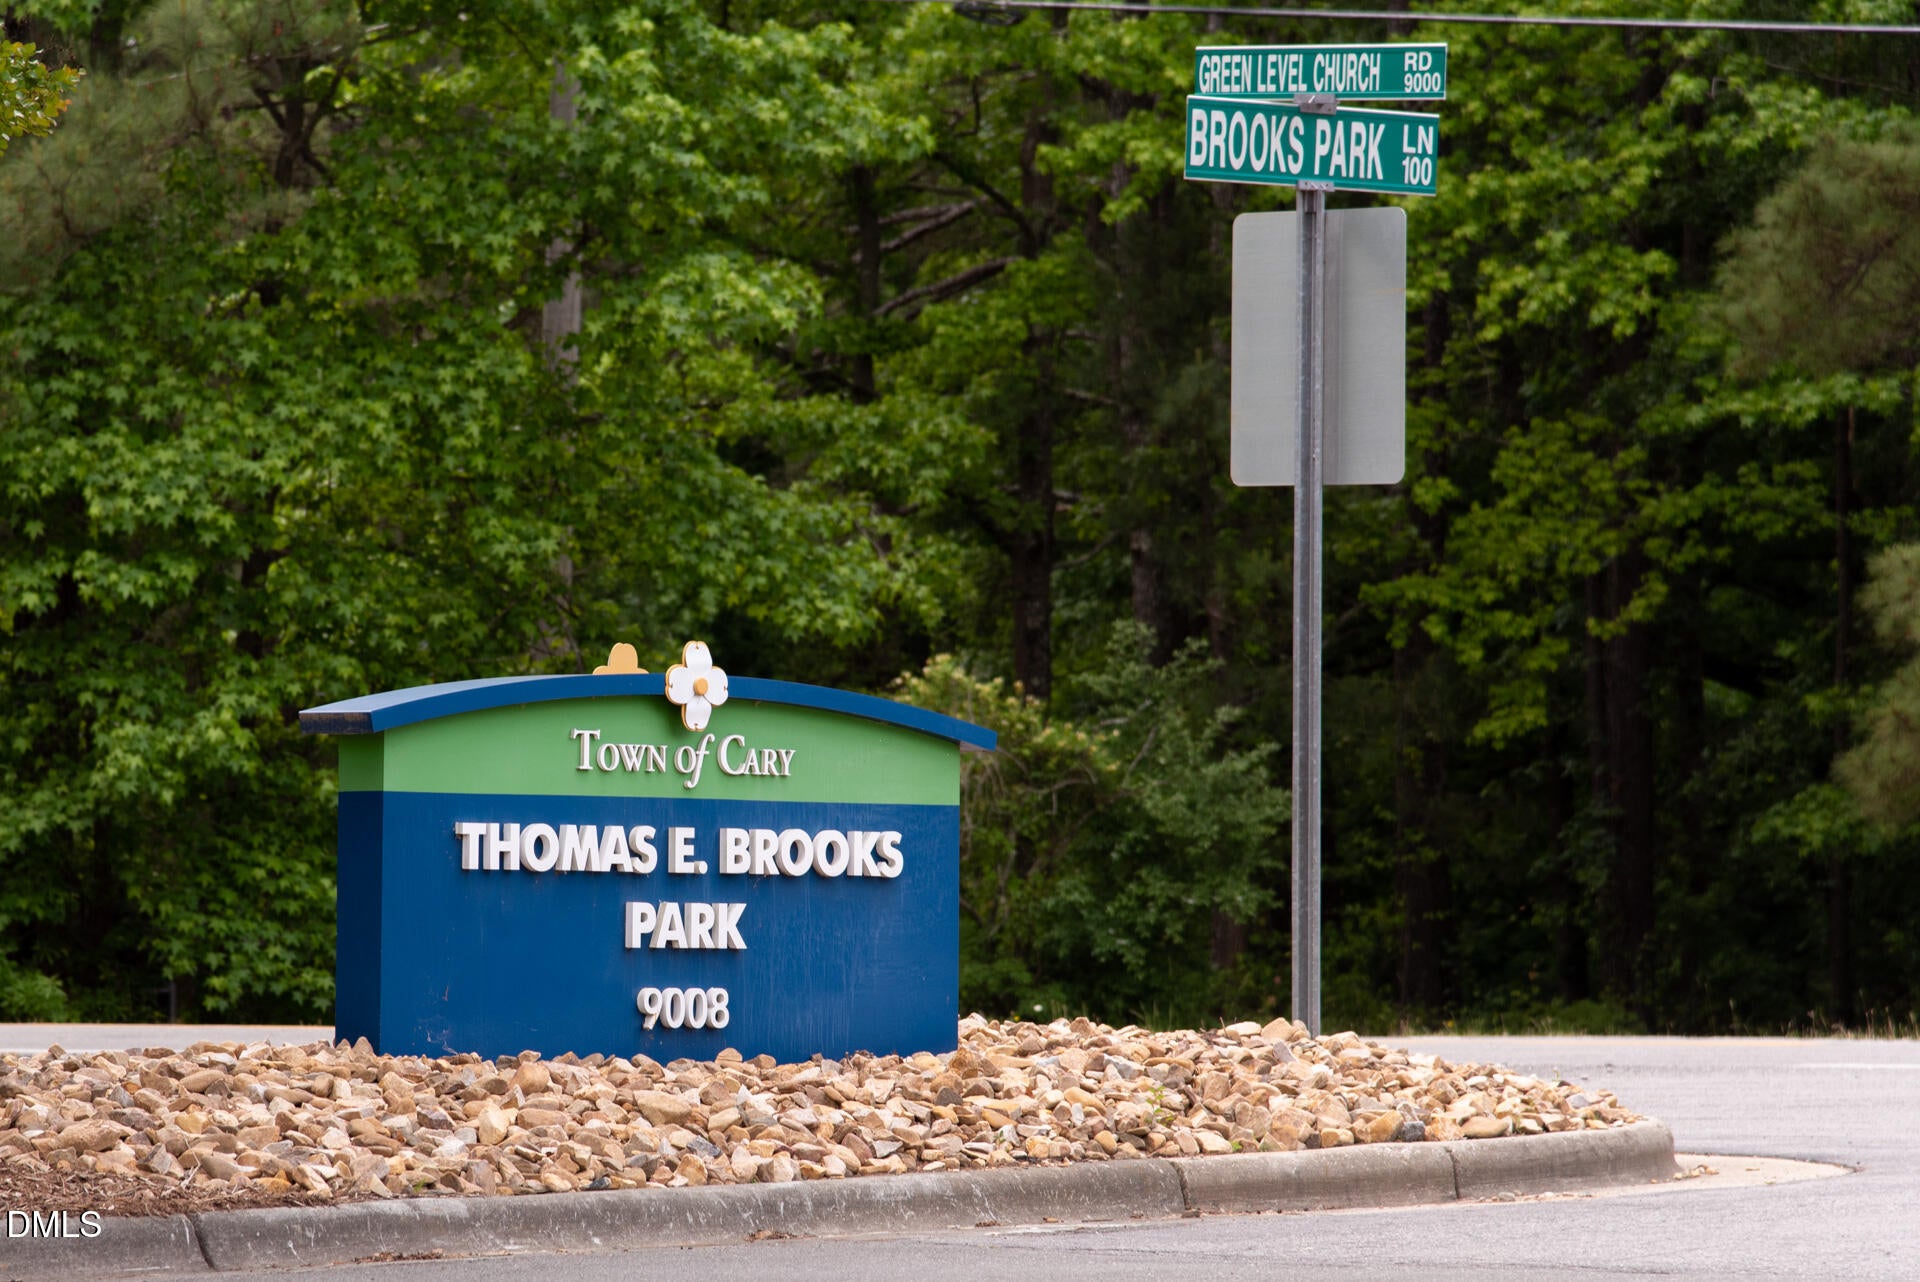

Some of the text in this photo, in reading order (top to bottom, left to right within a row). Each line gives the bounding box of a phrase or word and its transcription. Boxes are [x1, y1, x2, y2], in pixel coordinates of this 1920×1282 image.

[1199, 53, 1381, 93] GREEN LEVEL CHURCH
[1404, 51, 1432, 72] RD
[1404, 72, 1441, 93] 9000
[1189, 108, 1385, 180] BROOKS PARK
[1402, 124, 1434, 155] LN
[1401, 157, 1432, 186] 100
[674, 733, 715, 788] of
[455, 821, 904, 879] THOMAS E. BROOKS
[625, 901, 747, 949] PARK
[636, 987, 730, 1030] 9008
